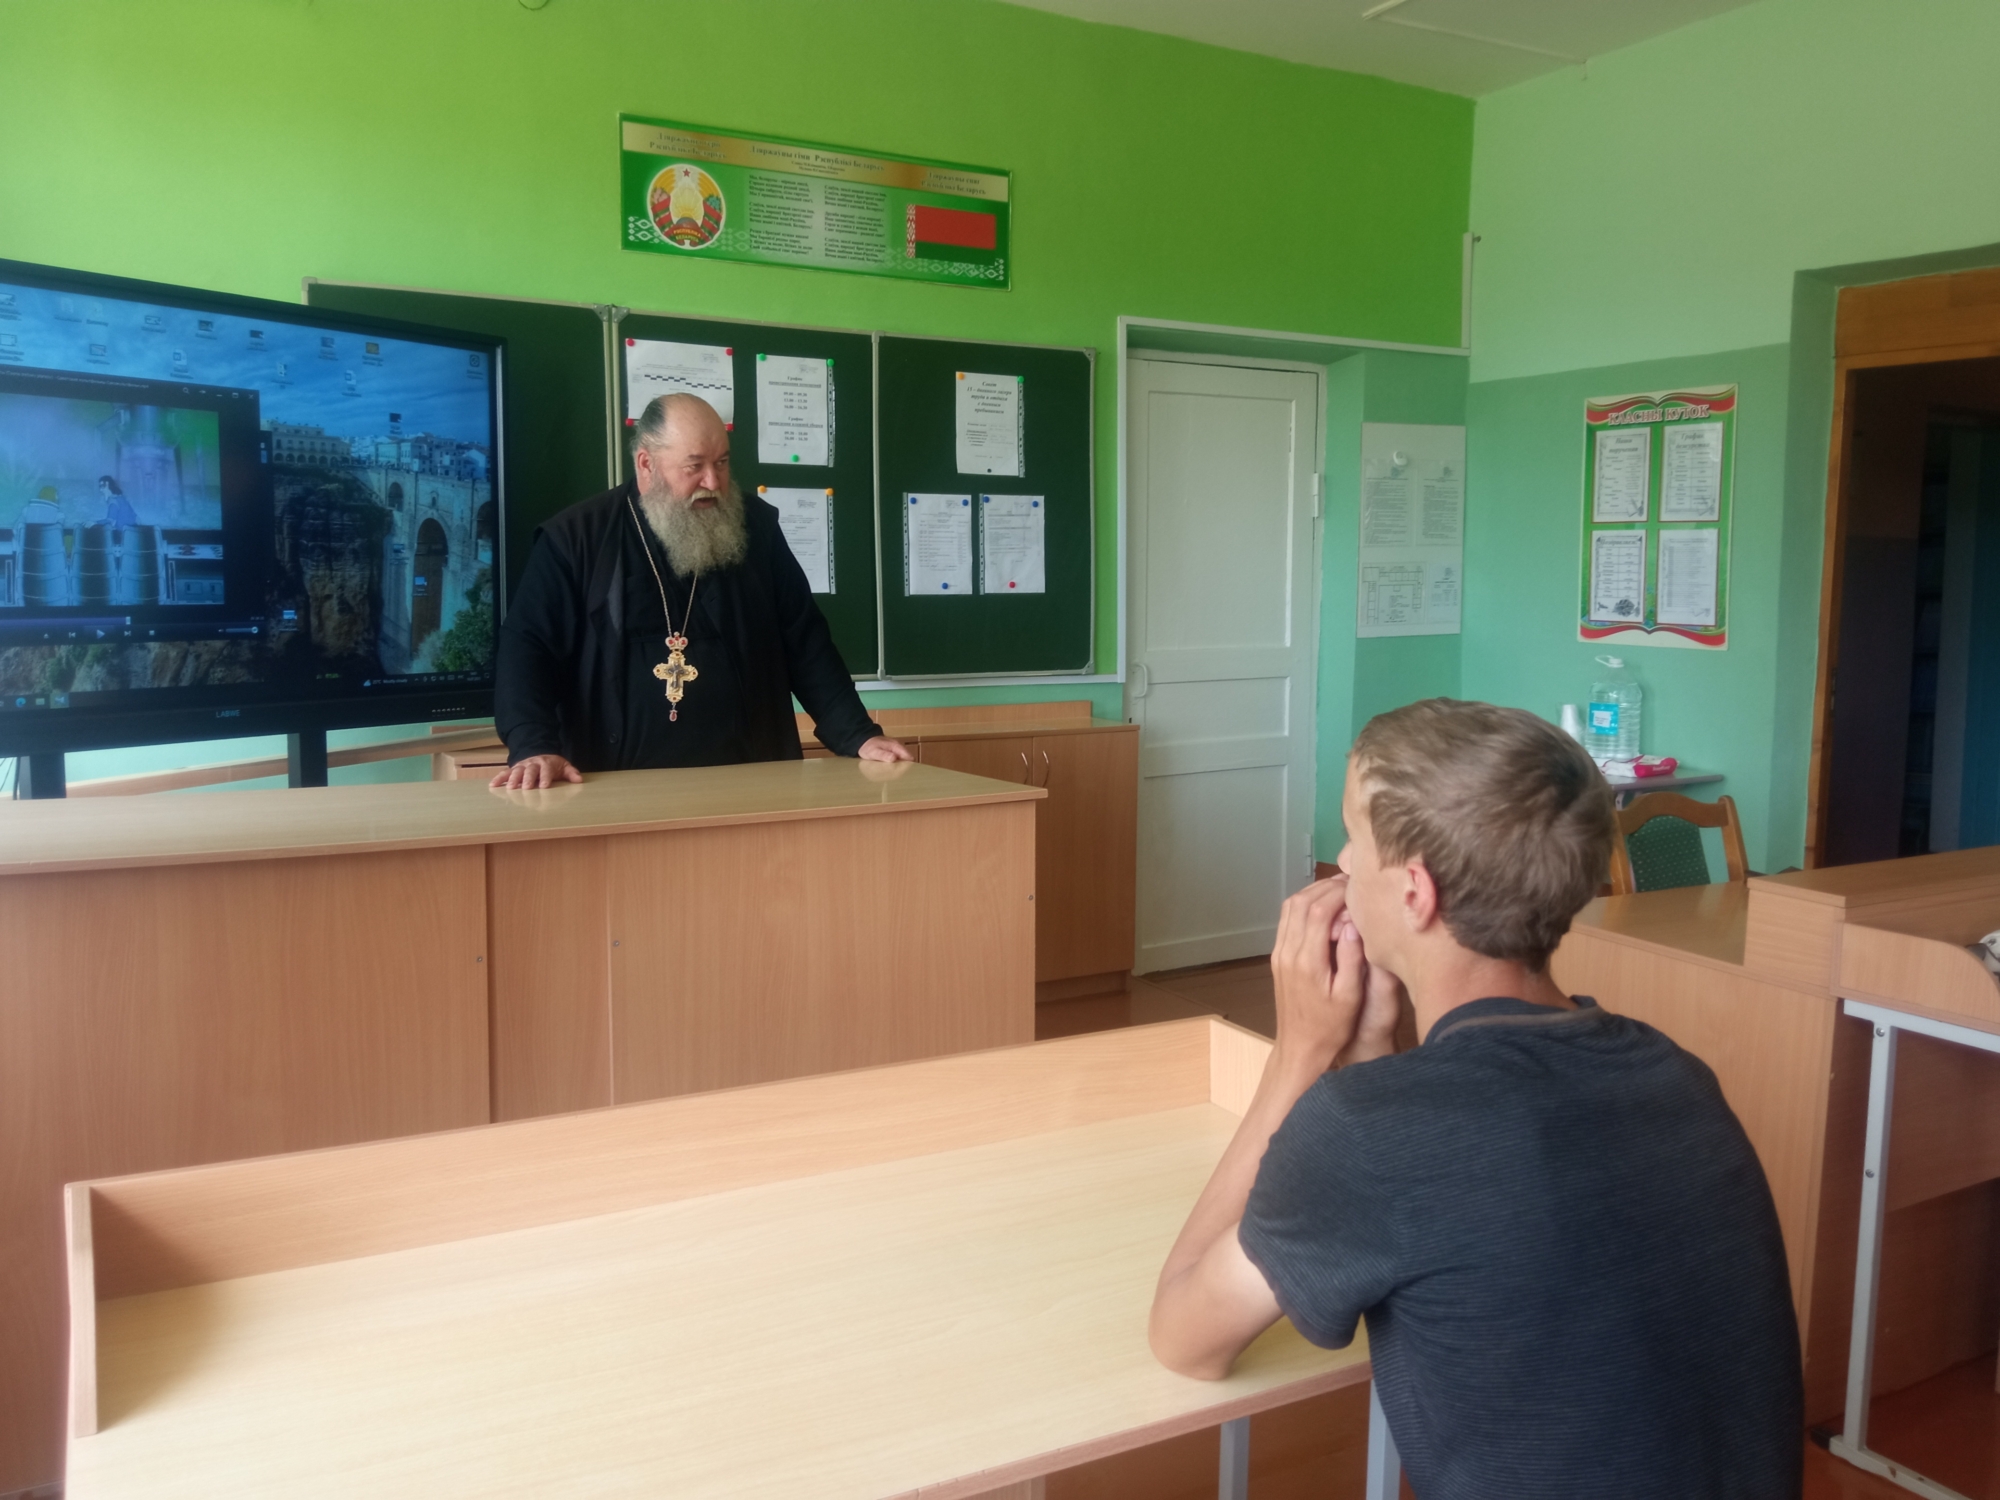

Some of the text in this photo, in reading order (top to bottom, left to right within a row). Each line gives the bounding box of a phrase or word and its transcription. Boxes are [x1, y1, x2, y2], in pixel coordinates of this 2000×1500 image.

[1608, 404, 1710, 426] КЛАСНЫ КУТОК
[215, 709, 241, 718] LABWE
